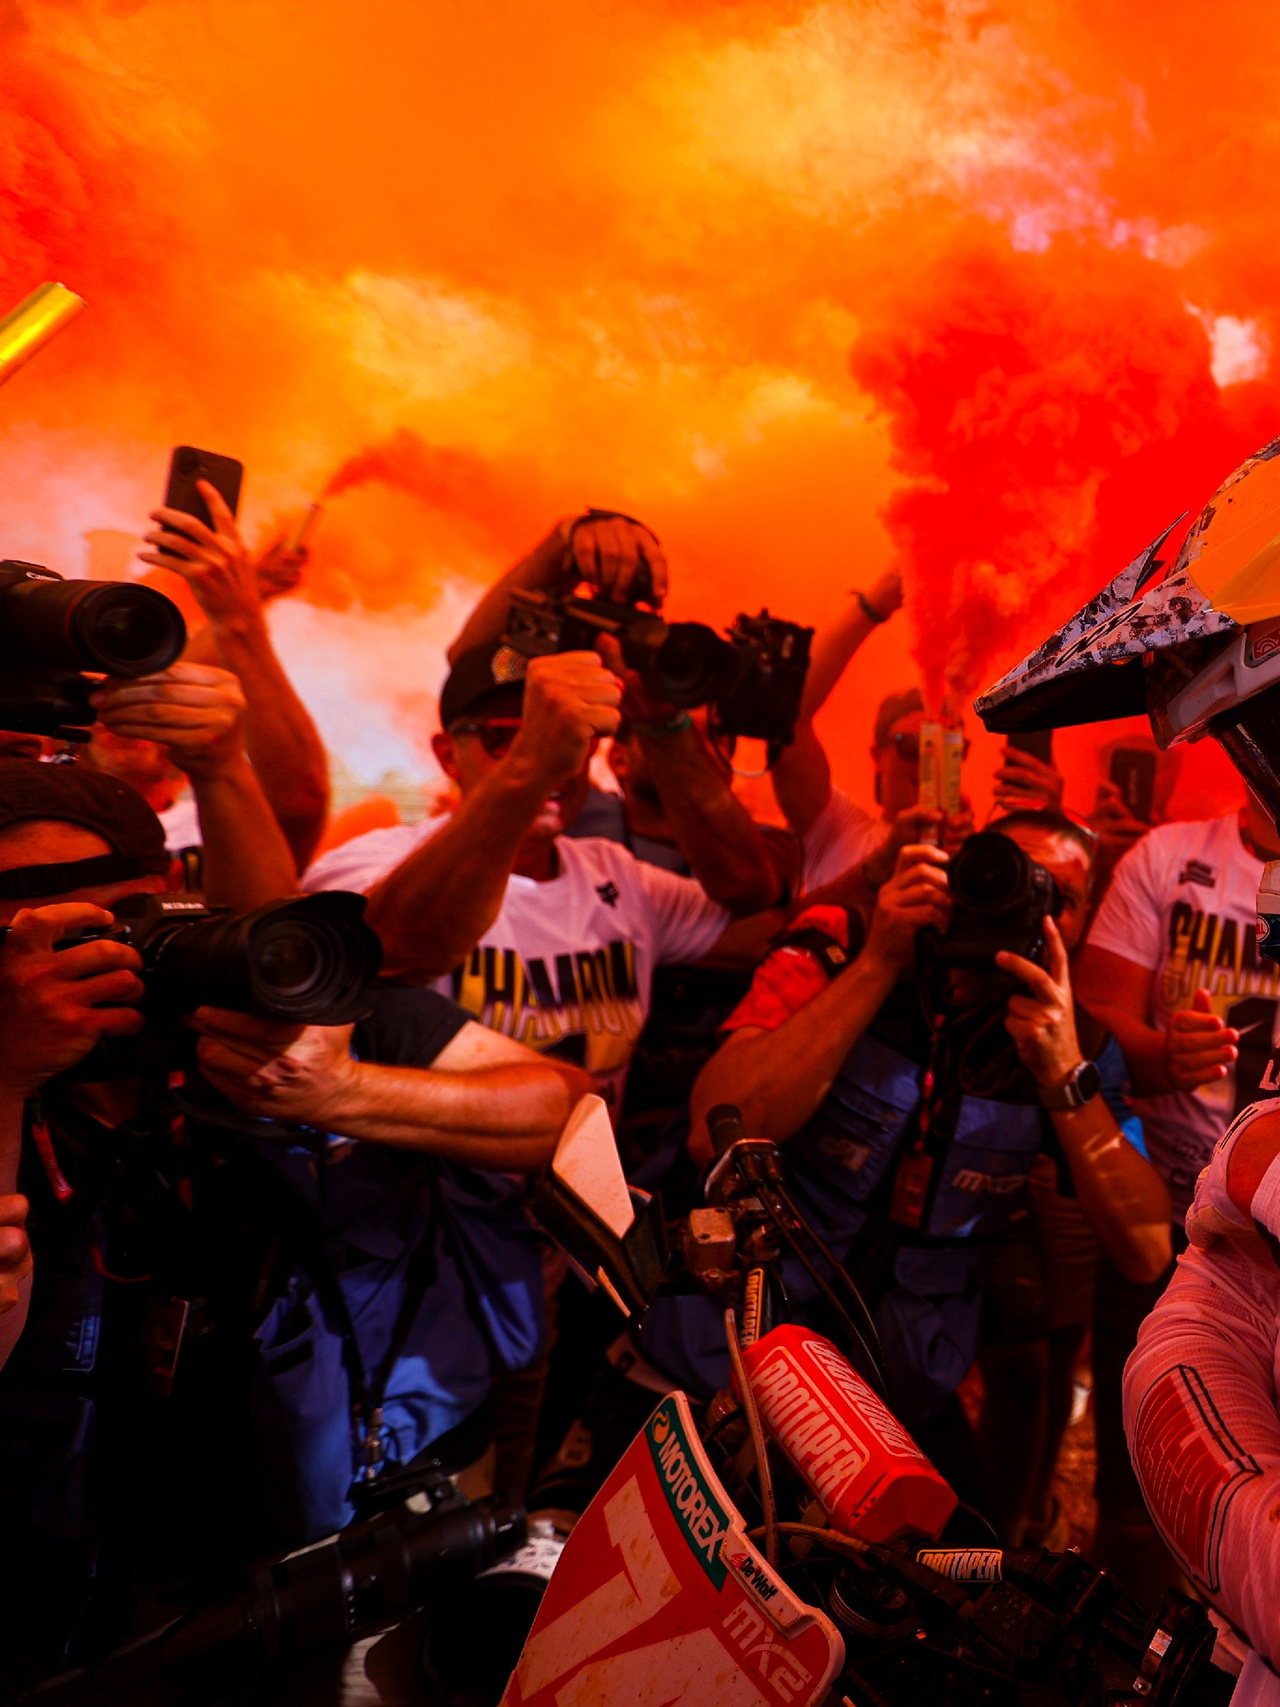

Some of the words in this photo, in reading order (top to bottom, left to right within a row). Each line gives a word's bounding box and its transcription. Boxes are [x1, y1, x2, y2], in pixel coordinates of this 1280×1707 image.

[750, 1358, 866, 1501] PROTAPER
[658, 1432, 727, 1563] MOTOREX
[741, 1557, 755, 1578] De
[751, 1574, 778, 1601] Wolf
[722, 1599, 813, 1704] MX2
